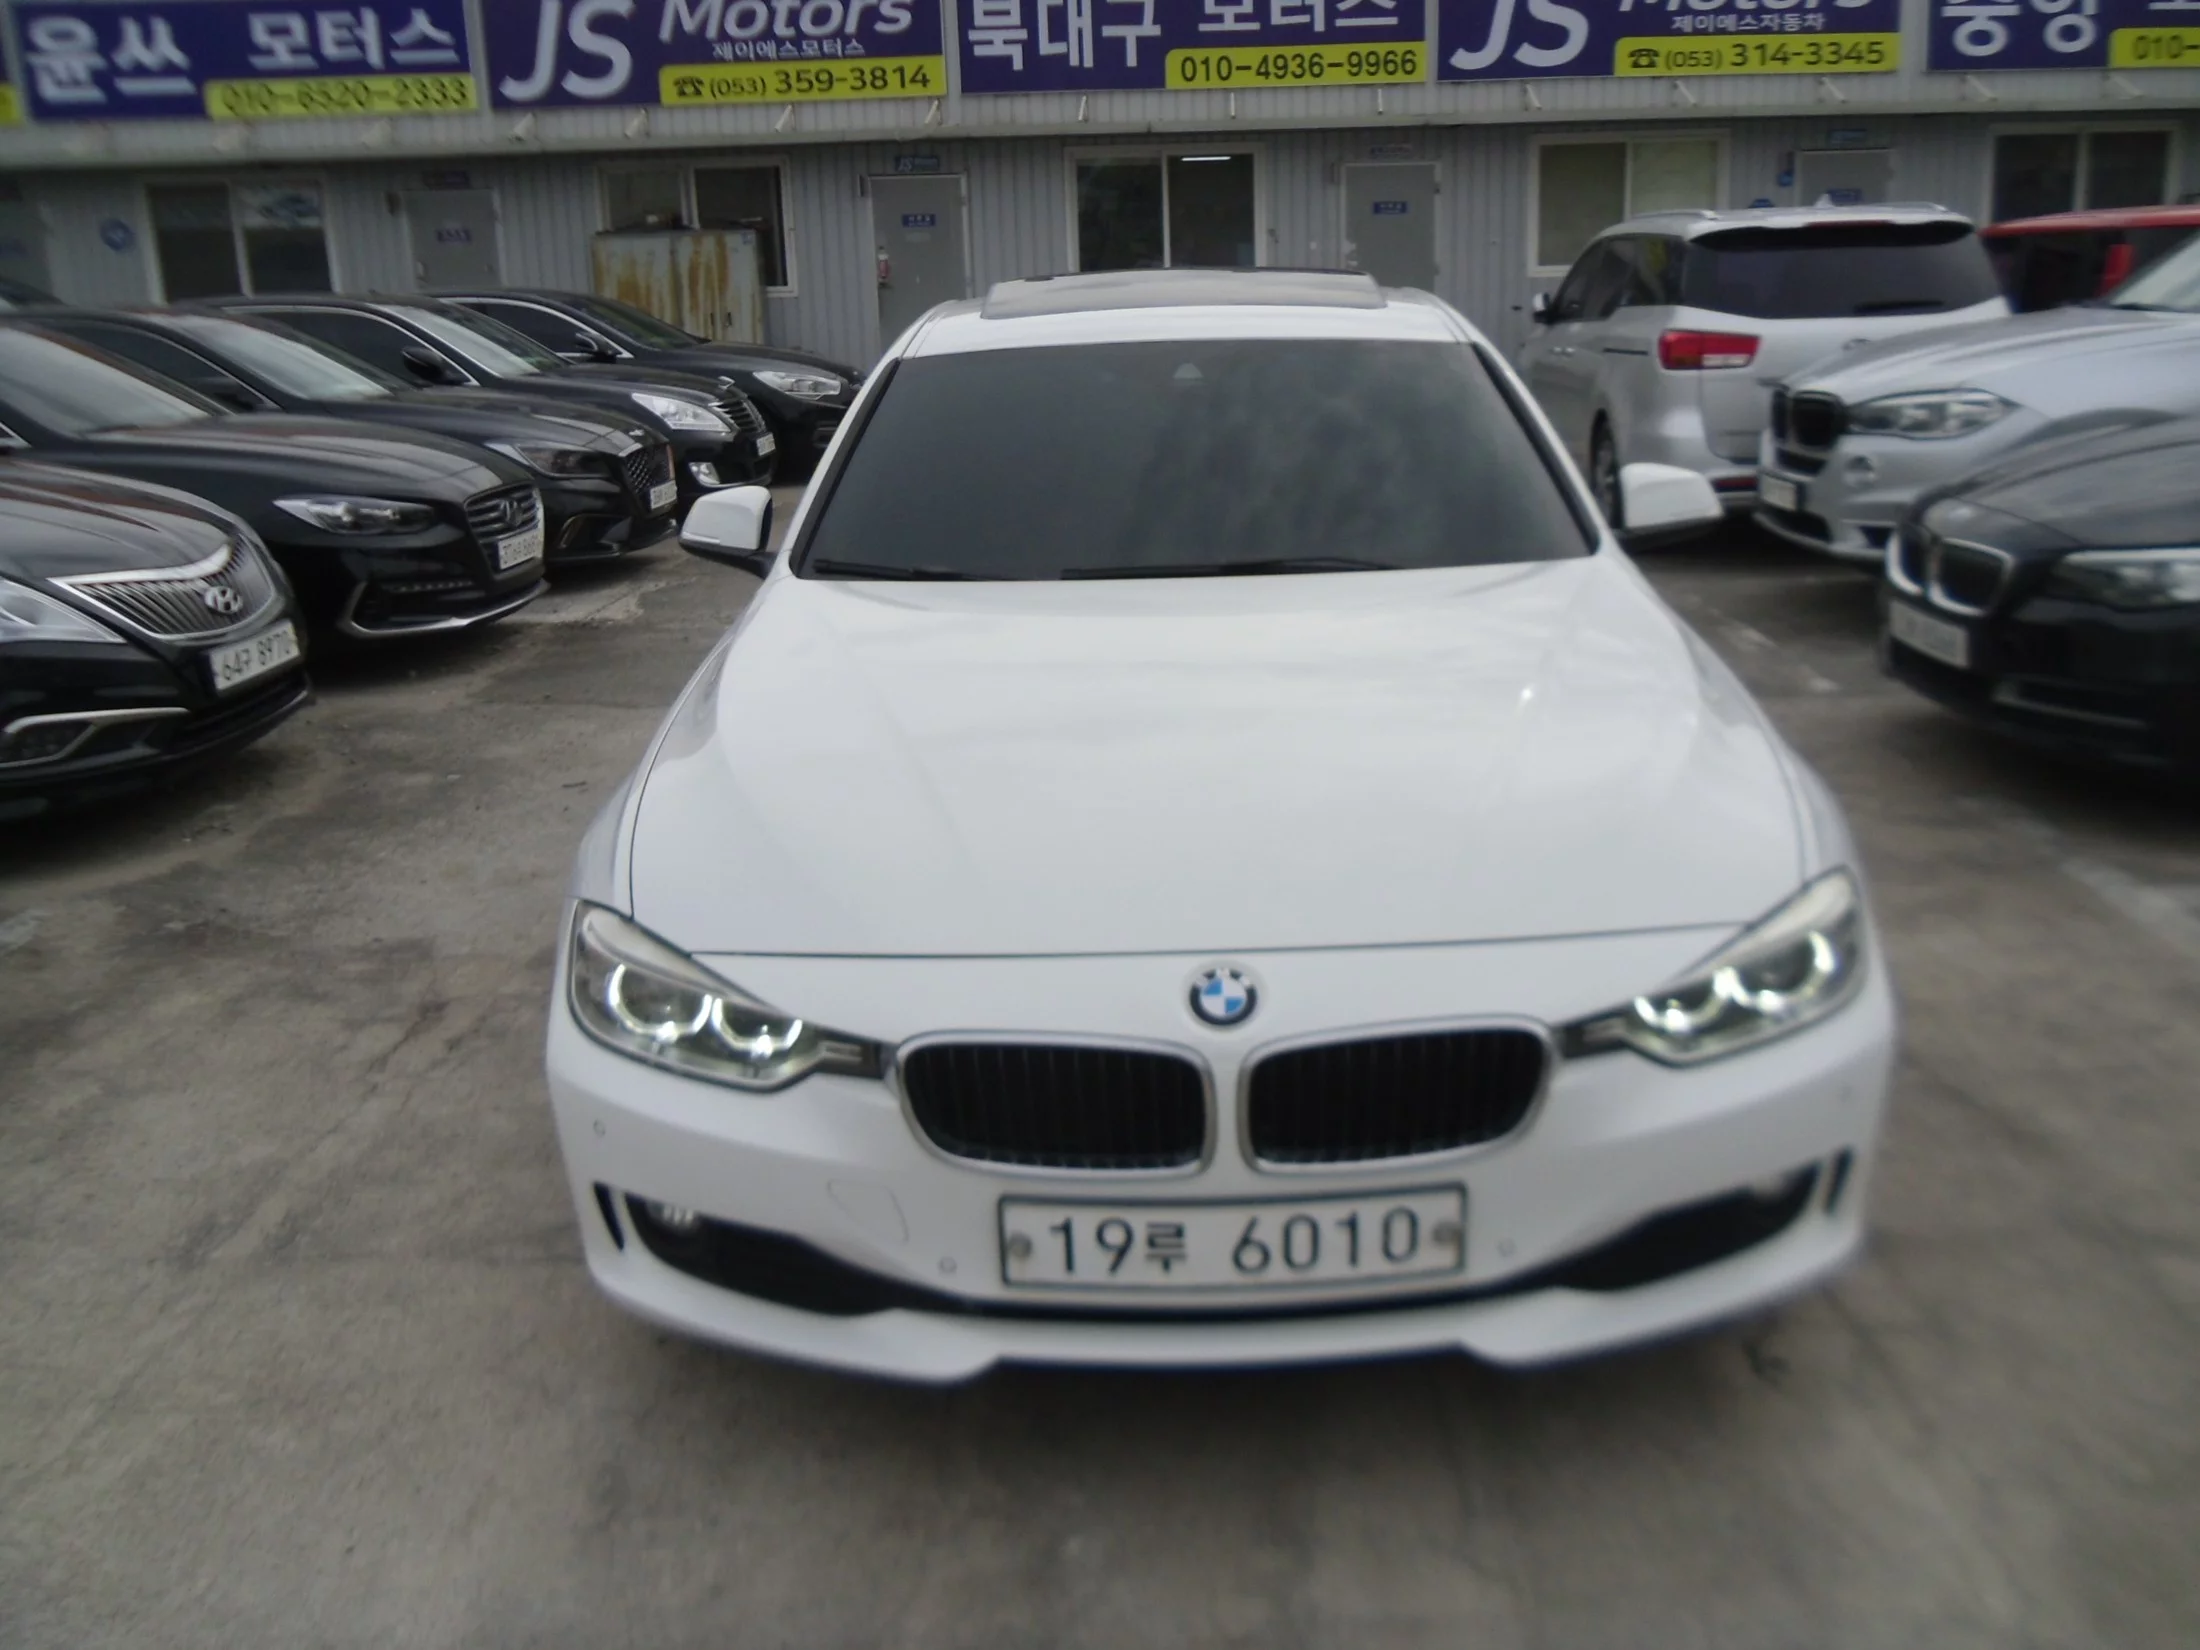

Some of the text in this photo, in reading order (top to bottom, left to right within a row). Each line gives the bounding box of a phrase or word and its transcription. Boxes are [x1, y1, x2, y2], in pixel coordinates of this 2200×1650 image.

[27, 7, 460, 103] 윤쓰 모터스
[498, 0, 913, 100] JS Motors
[711, 38, 866, 62] 제이에스모터스
[970, 0, 1162, 71] 북대구
[1181, 50, 1417, 83] 010-4936-9966
[1448, 0, 1590, 70] JS
[1665, 41, 1884, 70] (053) 314-3345
[708, 65, 931, 99] (053) 359-3814
[1049, 1206, 1419, 1275] 19루 6010
